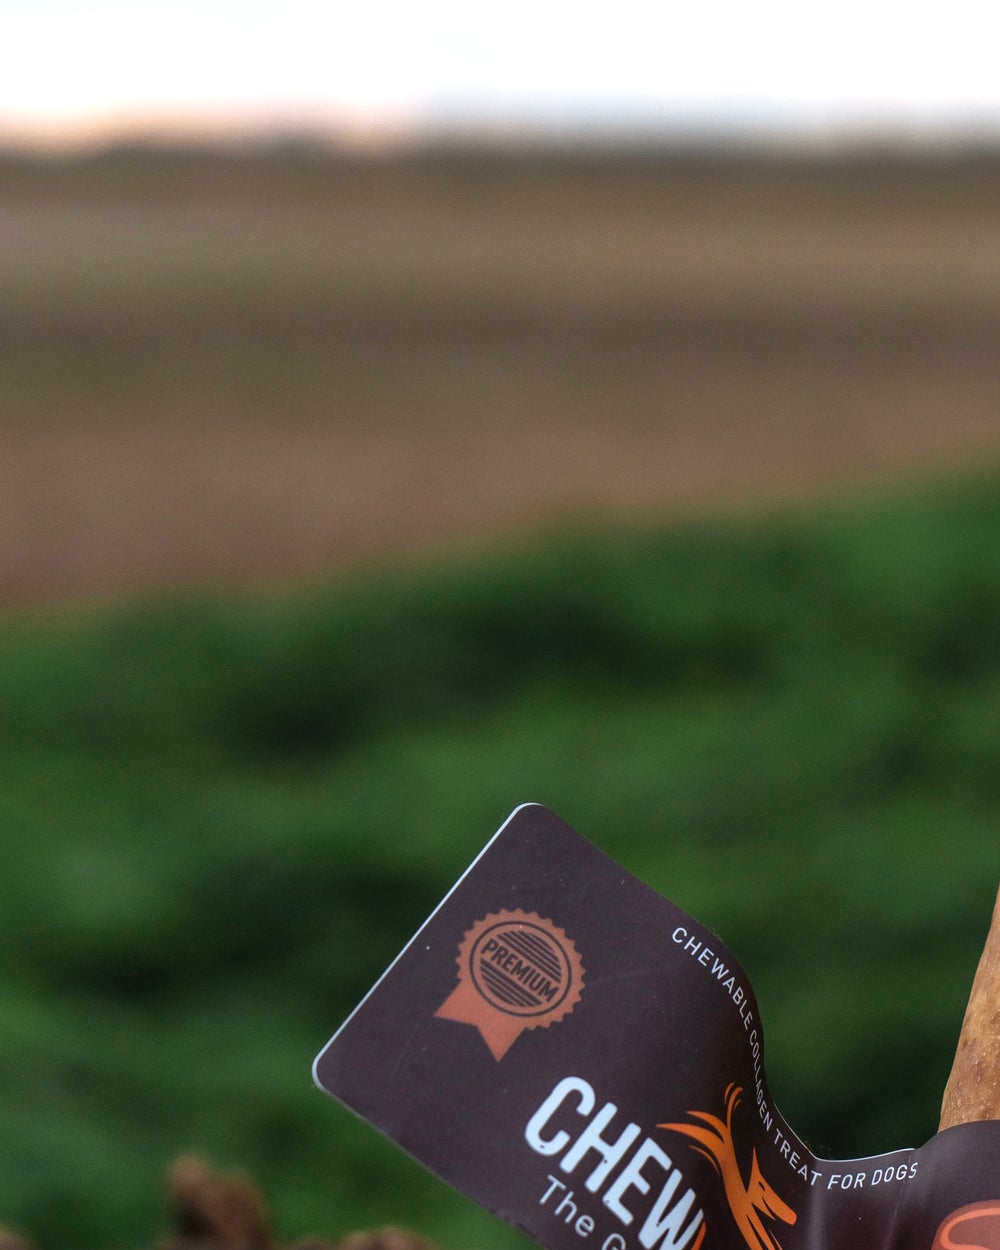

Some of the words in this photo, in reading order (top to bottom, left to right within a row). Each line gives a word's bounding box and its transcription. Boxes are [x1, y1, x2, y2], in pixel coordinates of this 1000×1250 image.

[481, 938, 560, 1002] PREMIUM
[672, 927, 753, 1030] CHEWABLE
[750, 1029, 773, 1132] COLLAGEN
[774, 1128, 822, 1186] TREAT
[827, 1173, 866, 1190] FOR
[871, 1162, 919, 1186] DOGS
[539, 1175, 595, 1238] The
